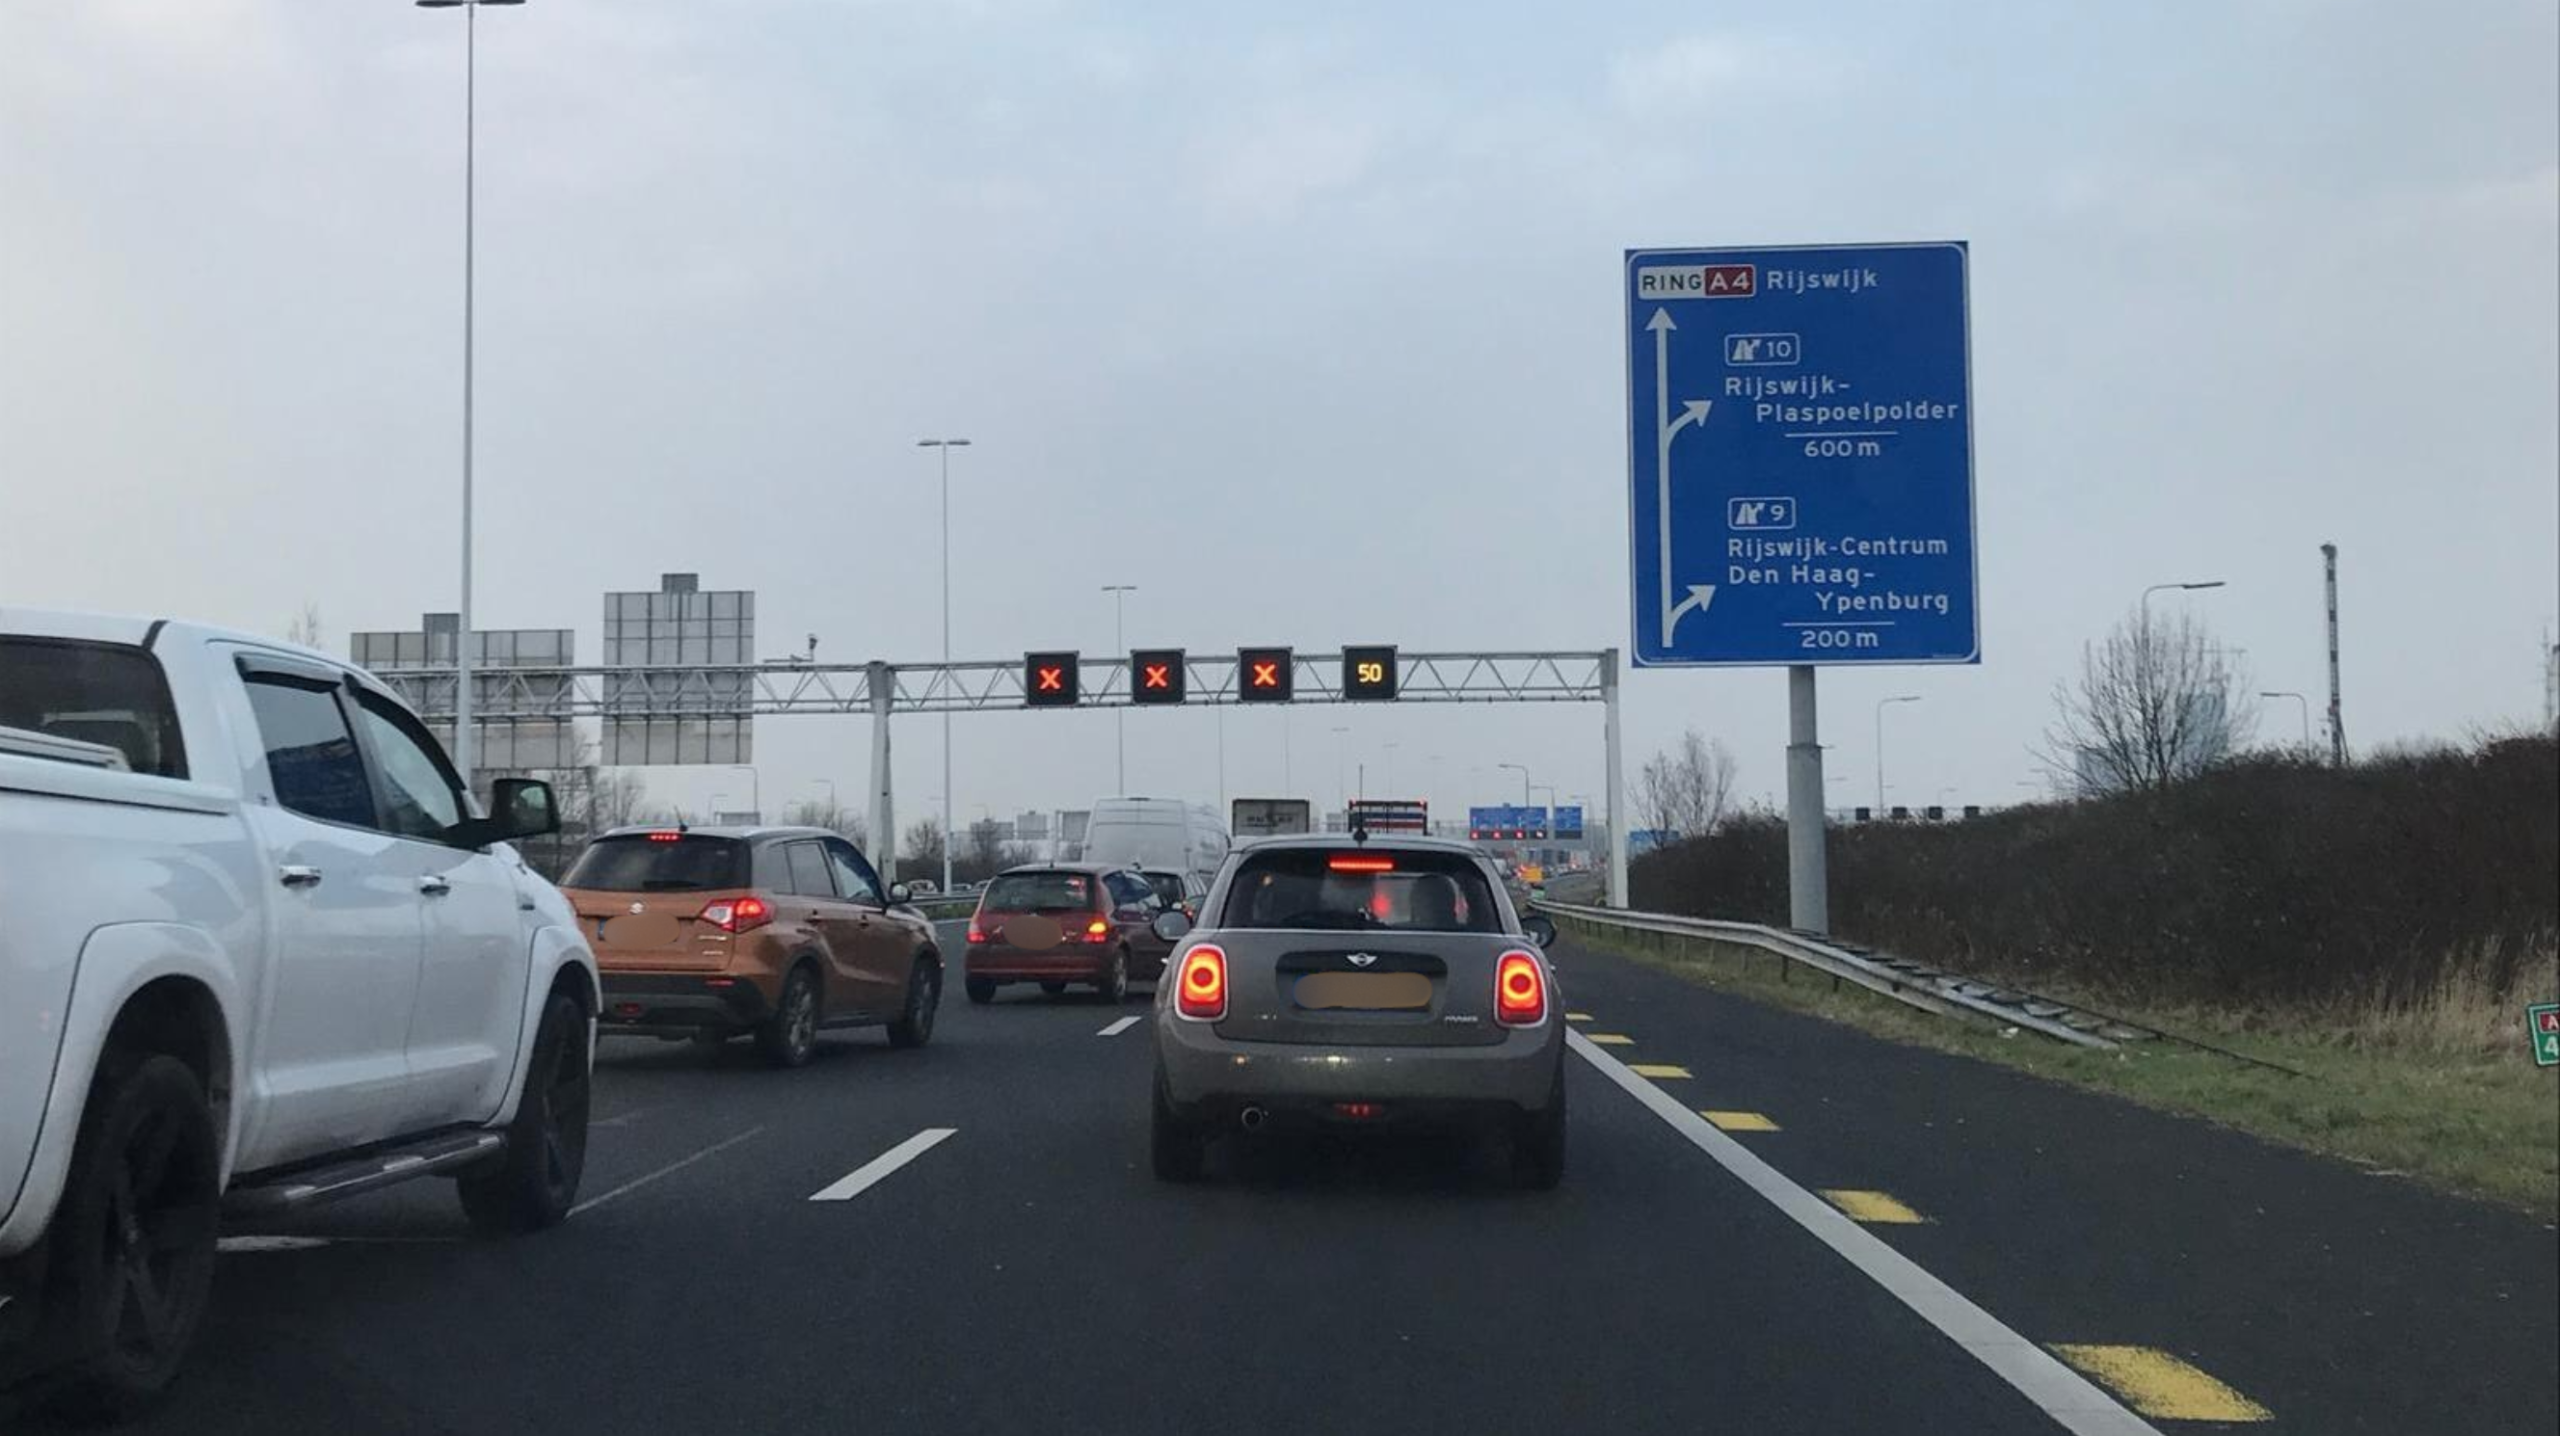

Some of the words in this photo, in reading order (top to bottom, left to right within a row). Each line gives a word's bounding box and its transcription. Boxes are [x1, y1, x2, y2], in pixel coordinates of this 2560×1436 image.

[1642, 274, 1702, 291] RING
[1709, 271, 1750, 291] A4
[1767, 269, 1878, 294] Rijswijk
[1766, 341, 1791, 357] 10
[1725, 376, 1850, 400] Rijswijk-
[1757, 403, 1958, 424] Plaspoelpolder
[1804, 441, 1852, 457] 600
[1858, 443, 1880, 456] m
[1770, 505, 1783, 521] 9
[1728, 537, 1948, 561] Rijswijk-Centrum
[1729, 565, 1779, 584] Den
[1791, 565, 1875, 588] Haag-
[1816, 592, 1949, 614] Ypenburg
[1801, 632, 1849, 648] 200
[1856, 634, 1878, 647] m
[1358, 664, 1382, 682] 50
